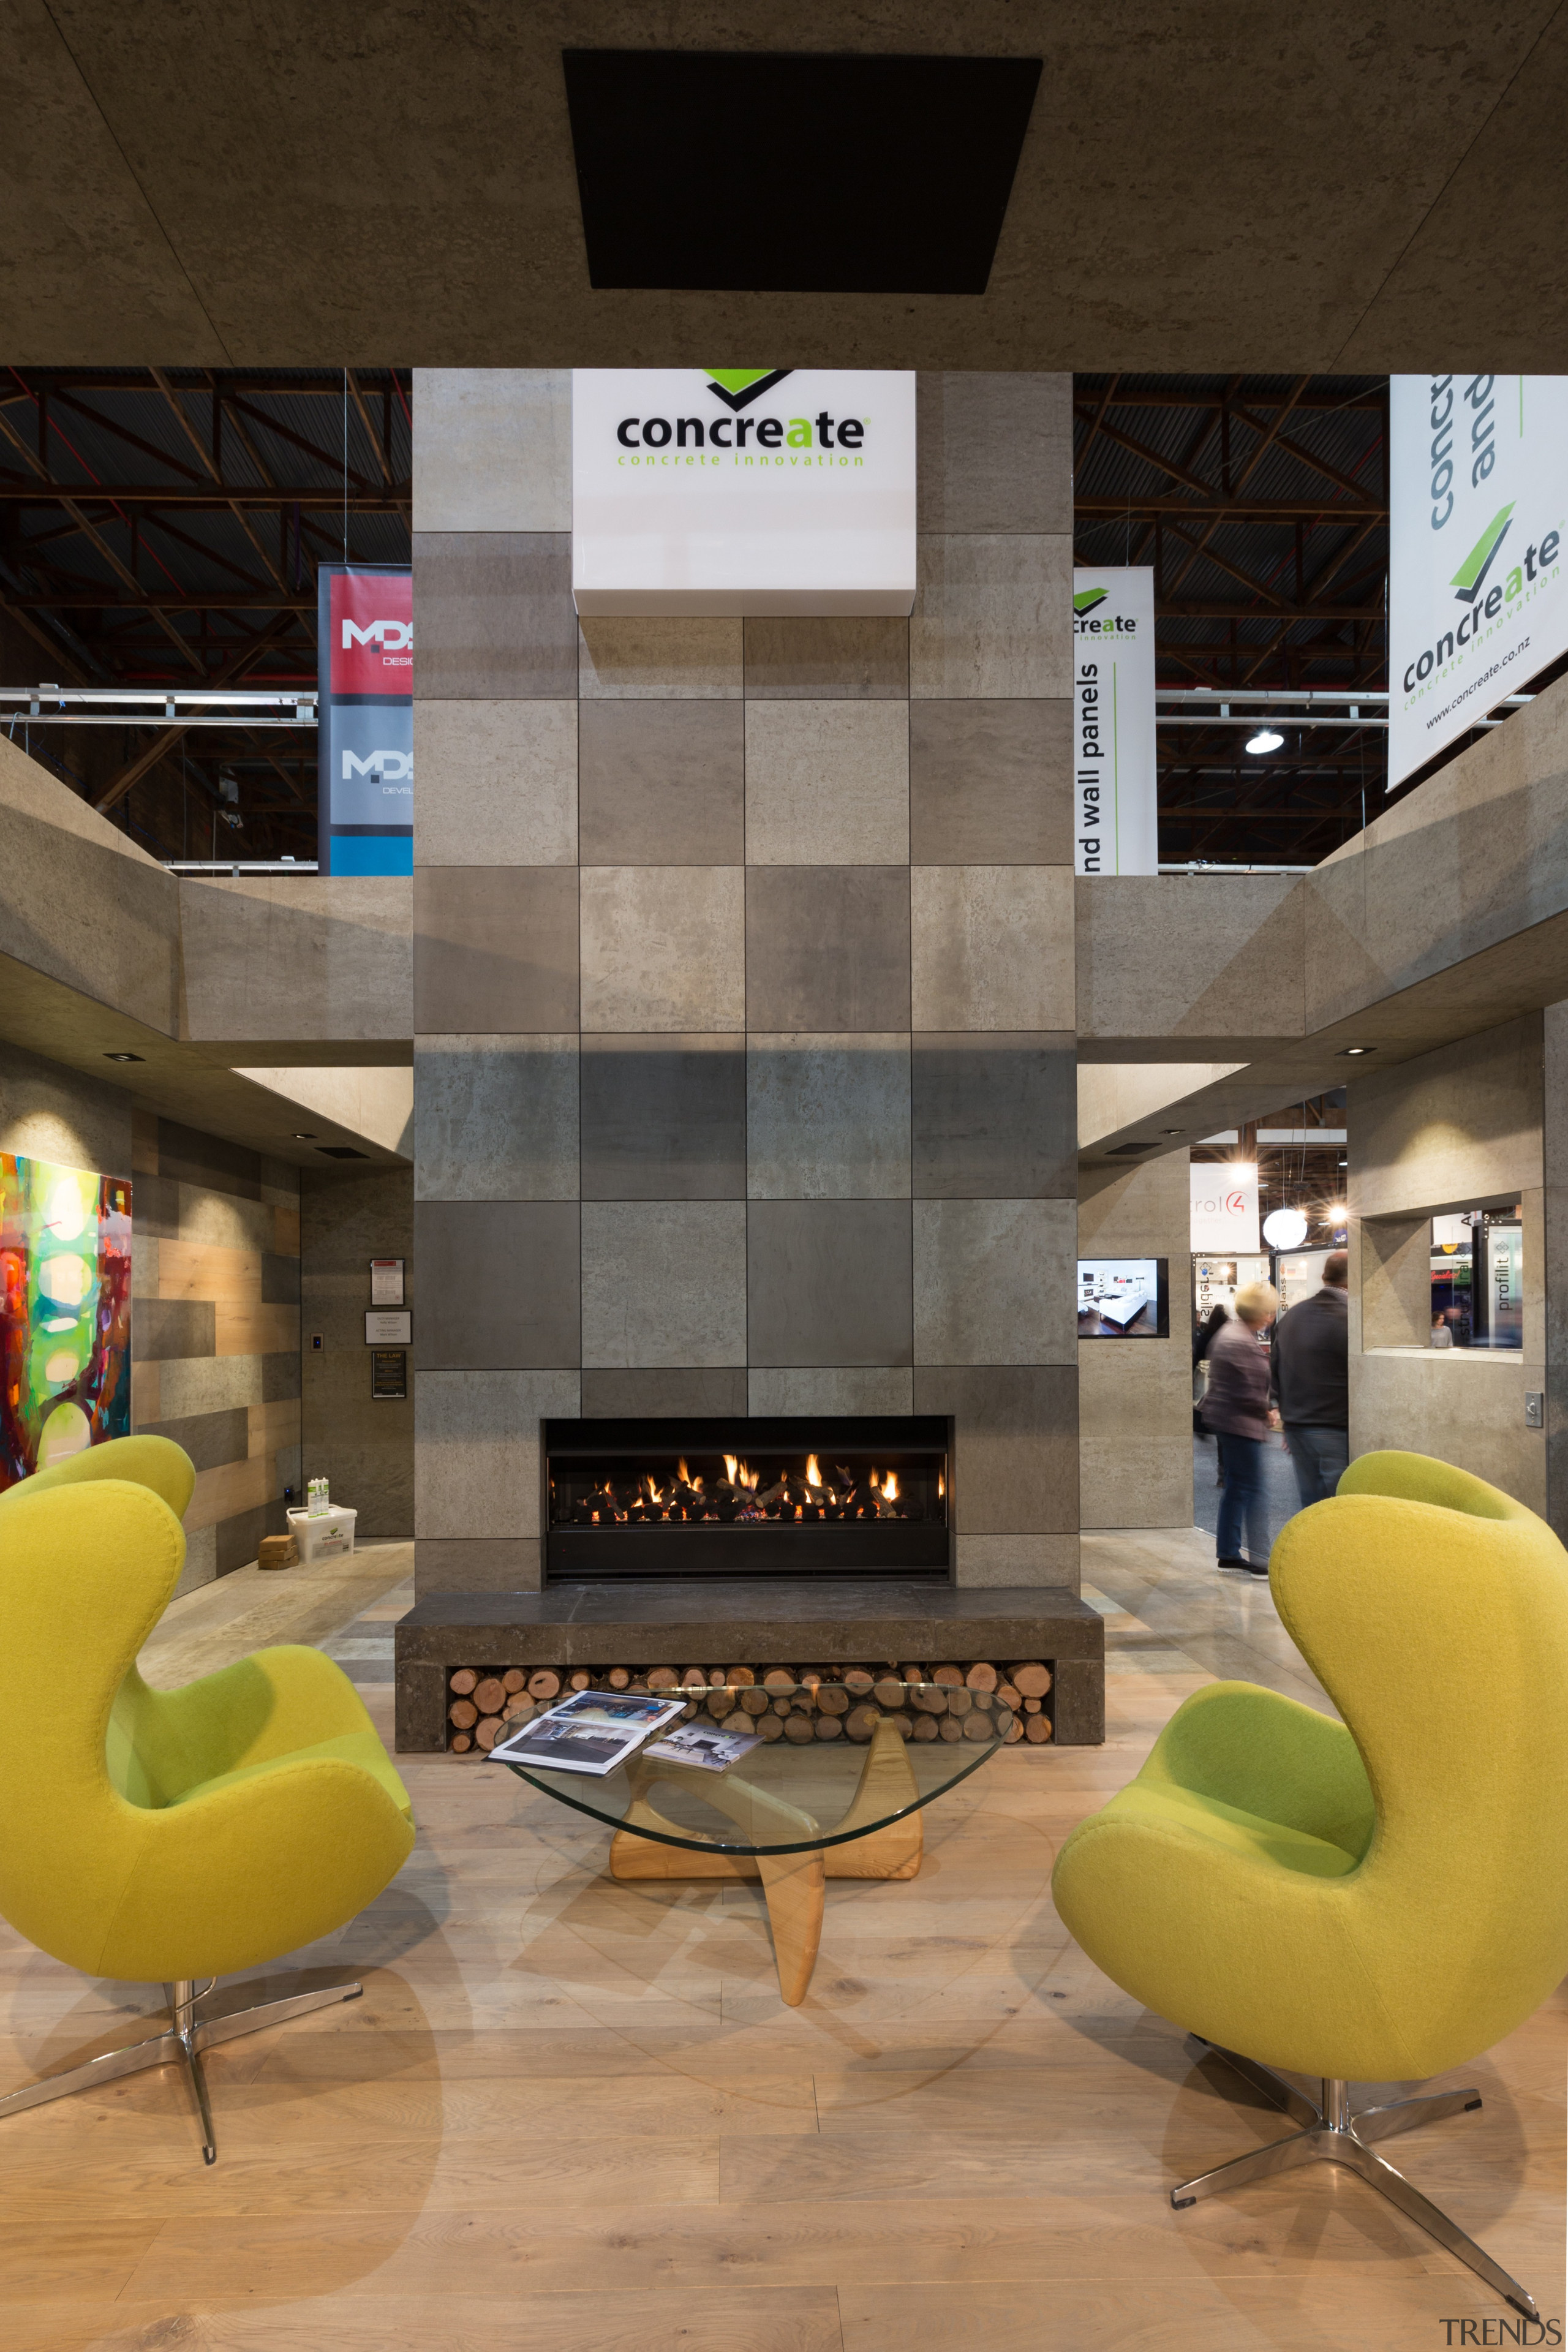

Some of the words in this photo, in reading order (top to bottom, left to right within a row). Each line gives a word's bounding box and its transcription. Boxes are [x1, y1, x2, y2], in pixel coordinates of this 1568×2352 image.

[617, 411, 864, 448] concreate
[618, 453, 720, 466] concrete
[735, 453, 864, 466] innovation
[1430, 375, 1453, 530] concr
[1403, 530, 1560, 693] concreate
[1404, 654, 1463, 711] concrete
[1471, 565, 1559, 652] innovation
[1076, 663, 1104, 758] panels
[1426, 636, 1531, 729] www.concreate.co.nz
[1077, 770, 1100, 827] wall
[1280, 1278, 1289, 1312] glass
[1495, 1257, 1513, 1311] profilit
